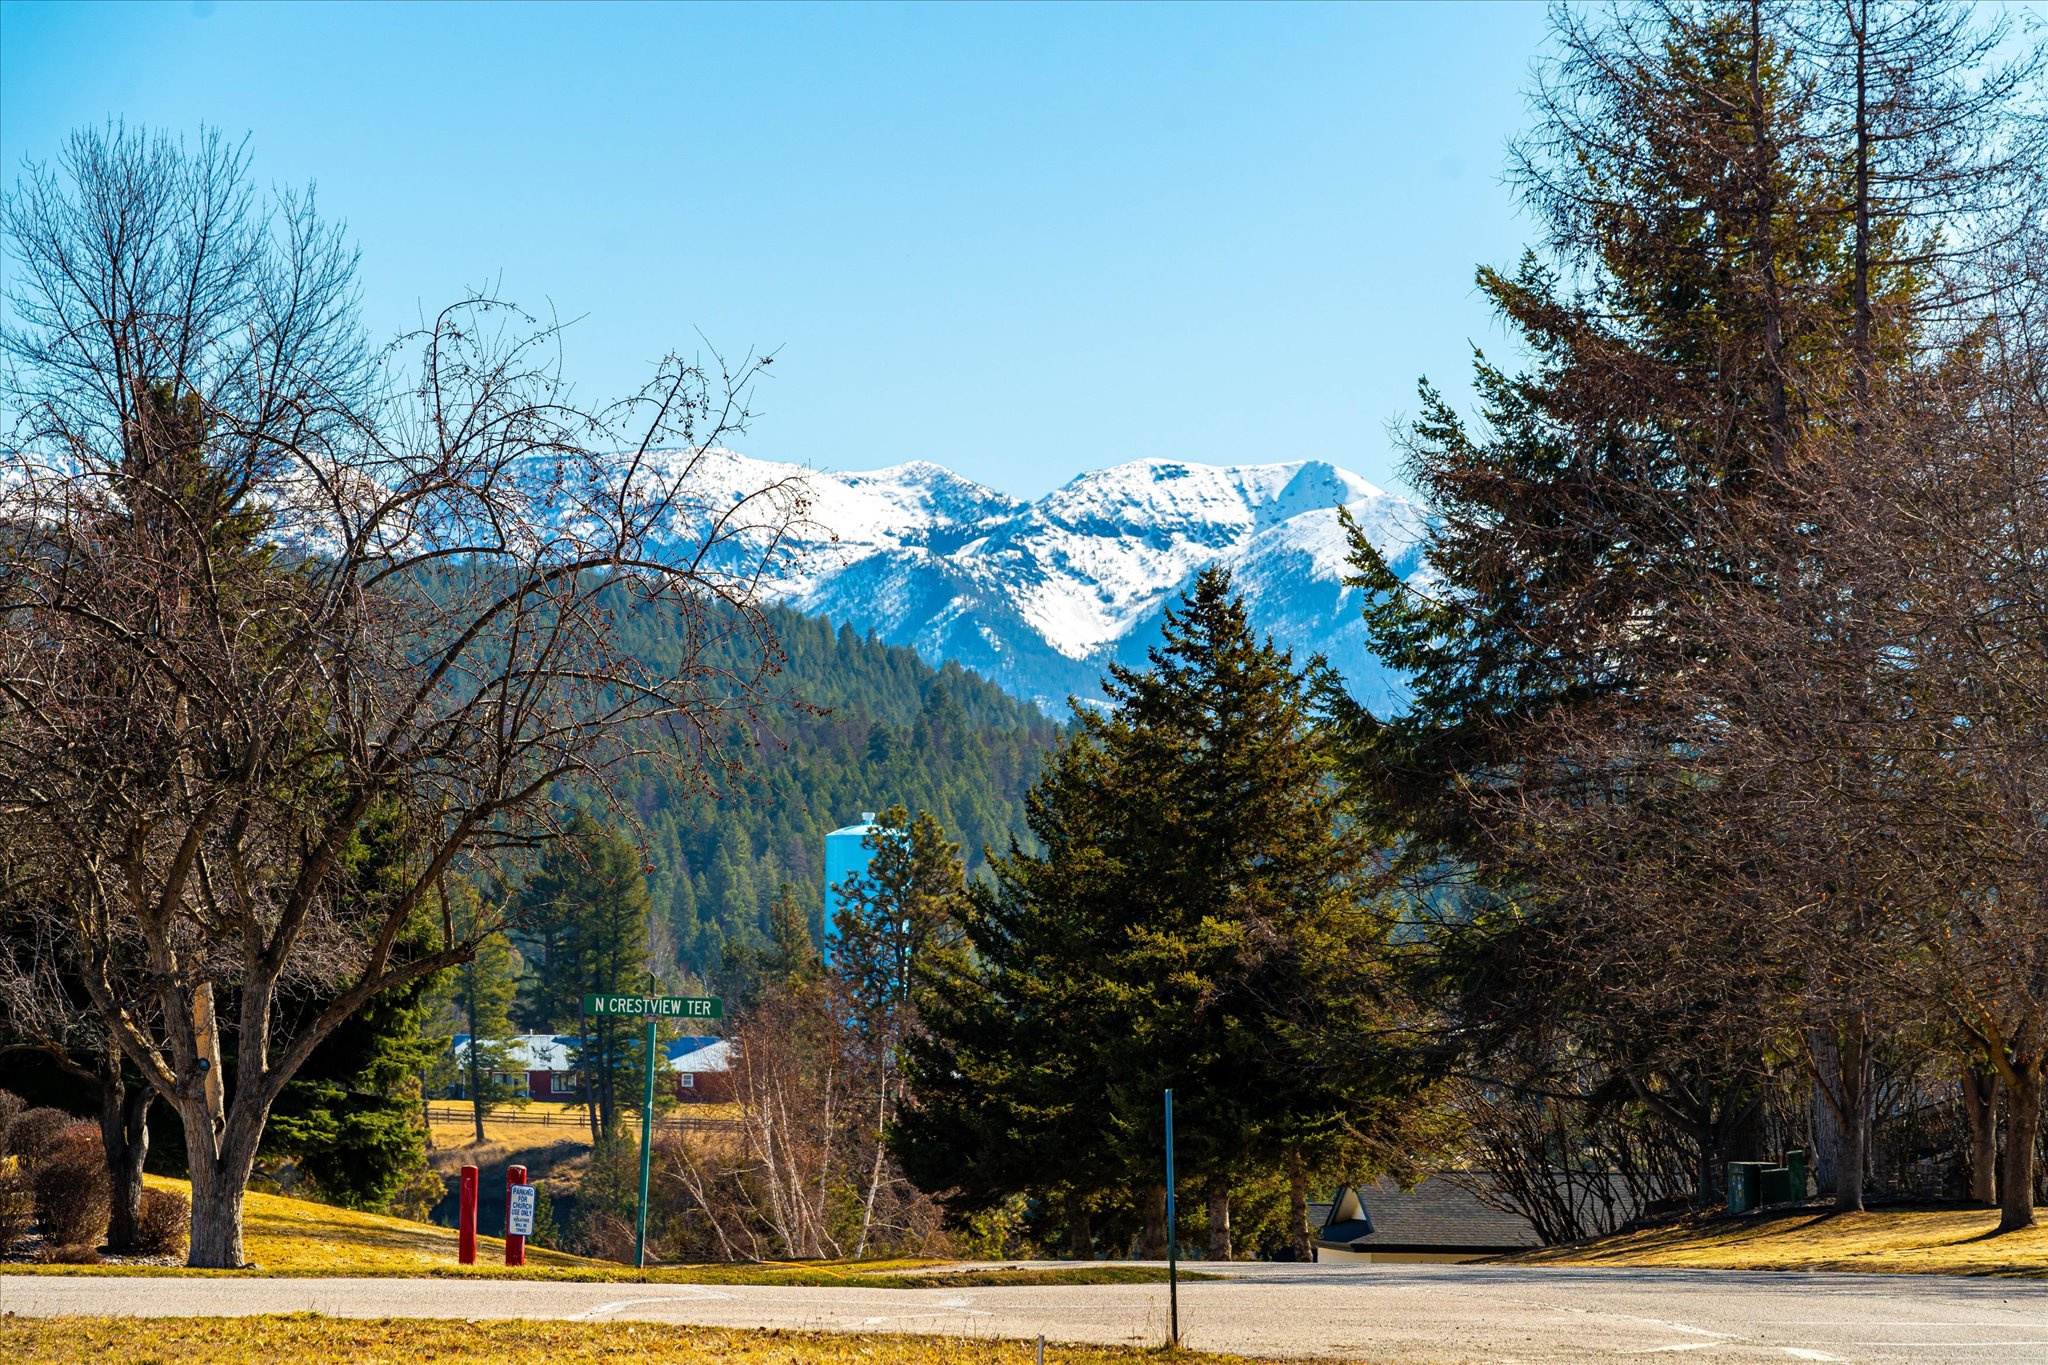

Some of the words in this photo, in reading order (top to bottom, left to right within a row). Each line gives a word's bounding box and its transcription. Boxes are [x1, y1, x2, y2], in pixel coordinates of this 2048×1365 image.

[595, 997, 604, 1012] N
[609, 998, 681, 1014] CRESTVIEW
[687, 1000, 711, 1015] TER
[513, 1188, 533, 1196] PARKING
